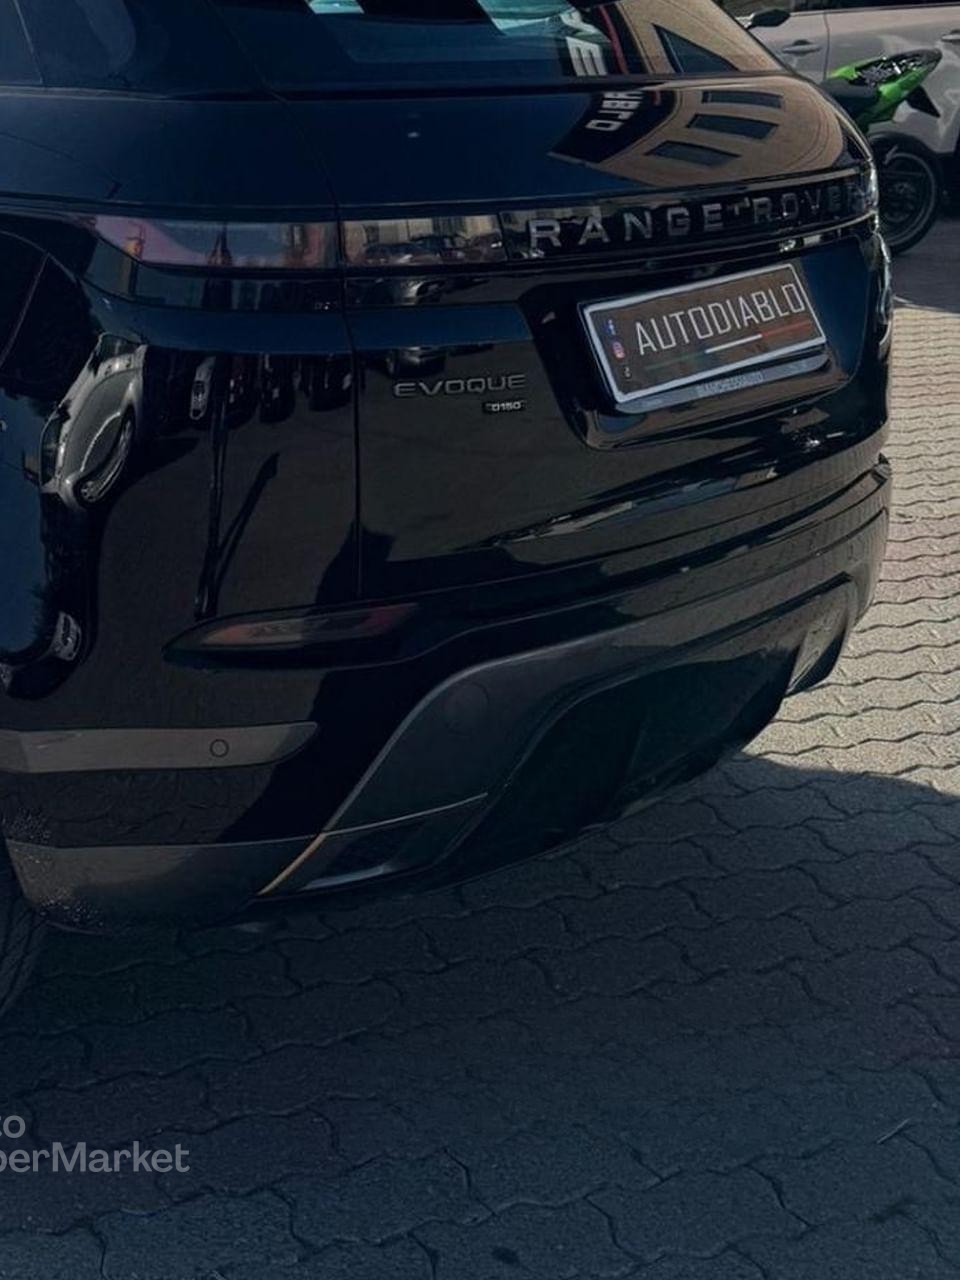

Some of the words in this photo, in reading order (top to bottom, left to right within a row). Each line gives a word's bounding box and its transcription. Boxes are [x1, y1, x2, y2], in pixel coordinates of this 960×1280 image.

[530, 202, 724, 249] RANGE
[753, 183, 866, 224] ROVER
[634, 282, 807, 356] AUTODIABLO
[394, 374, 526, 397] EVOQUE
